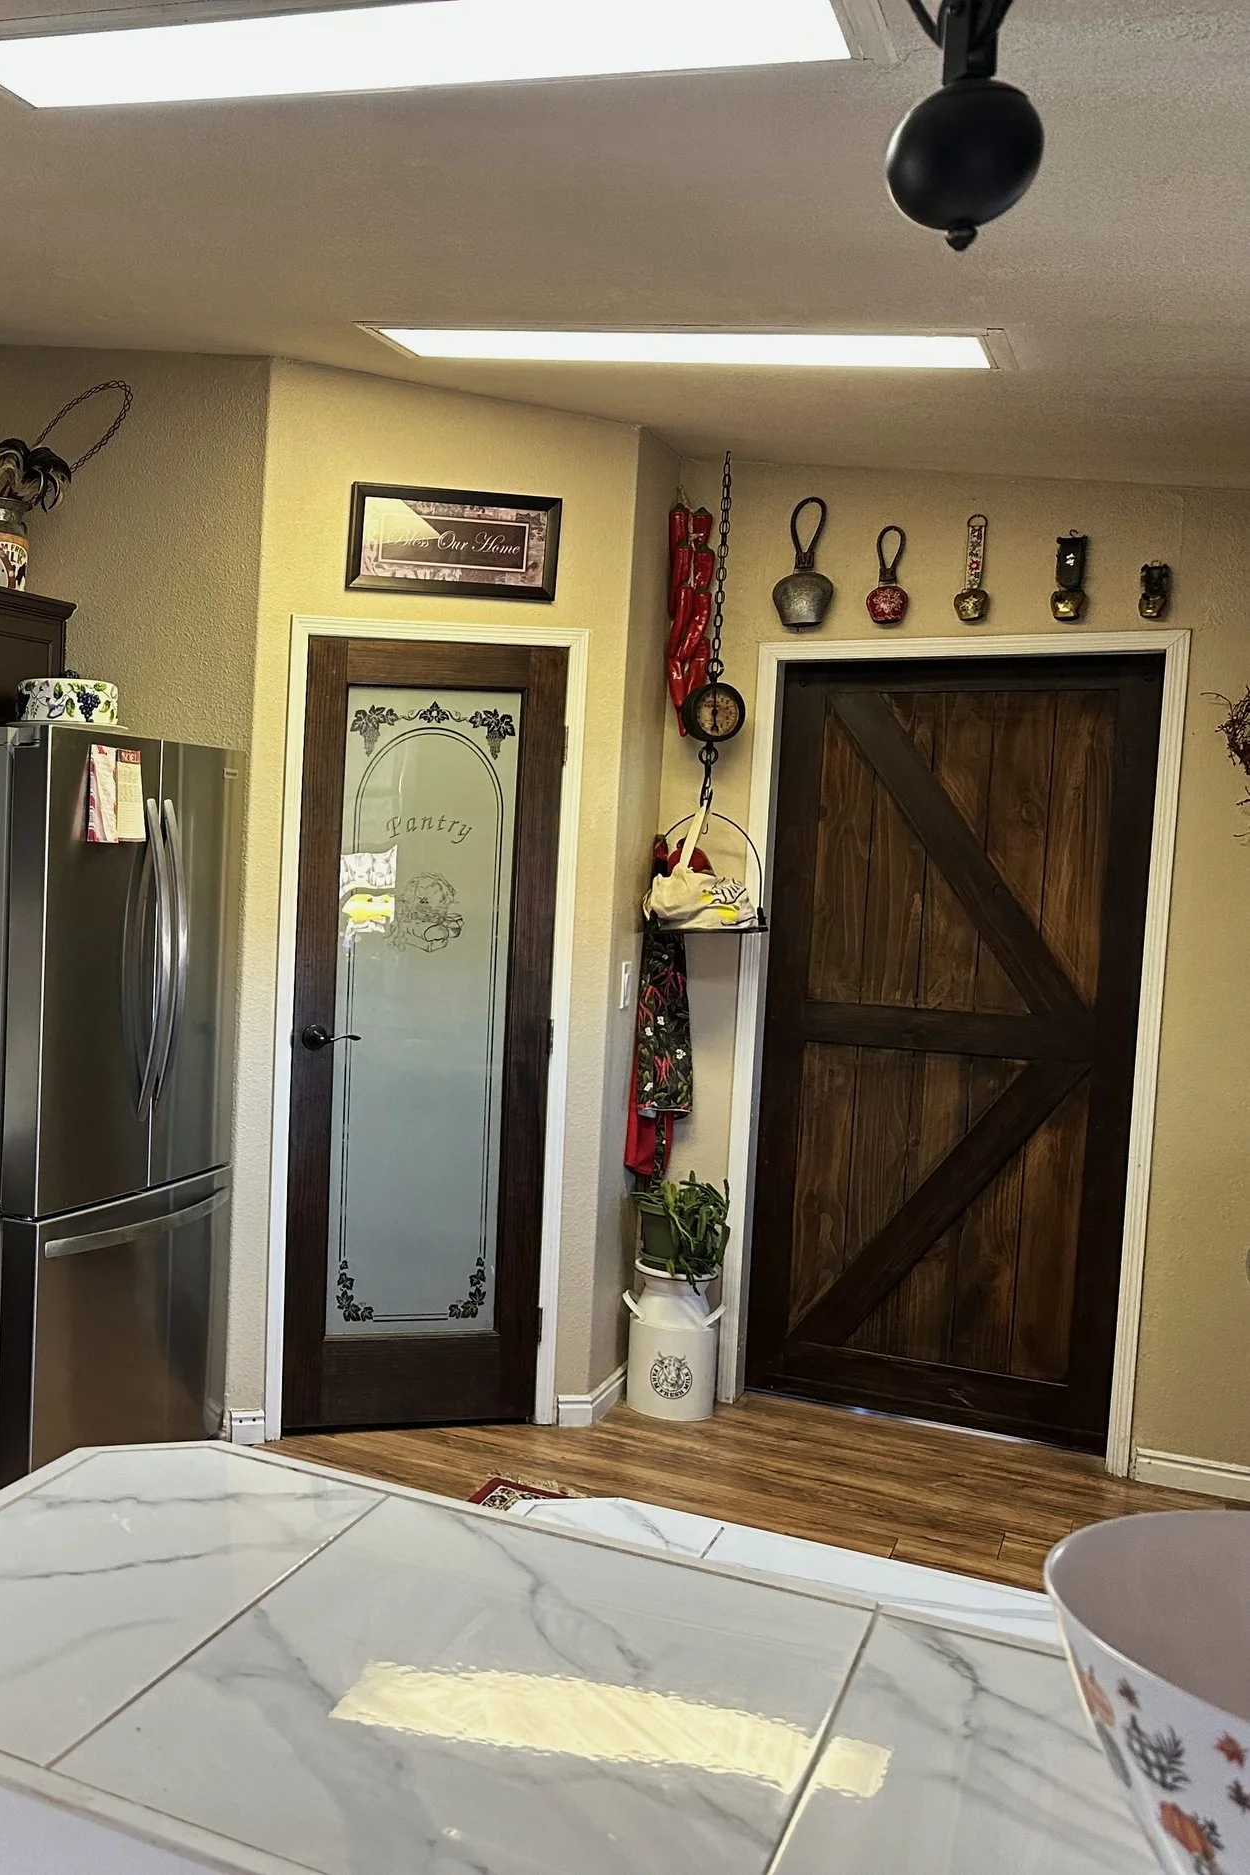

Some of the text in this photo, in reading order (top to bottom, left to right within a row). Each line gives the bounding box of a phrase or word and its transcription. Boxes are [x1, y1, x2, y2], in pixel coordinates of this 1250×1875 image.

[437, 530, 469, 550] Our
[471, 531, 521, 554] Home
[121, 751, 140, 763] NOEL
[386, 814, 472, 844] Pantry
